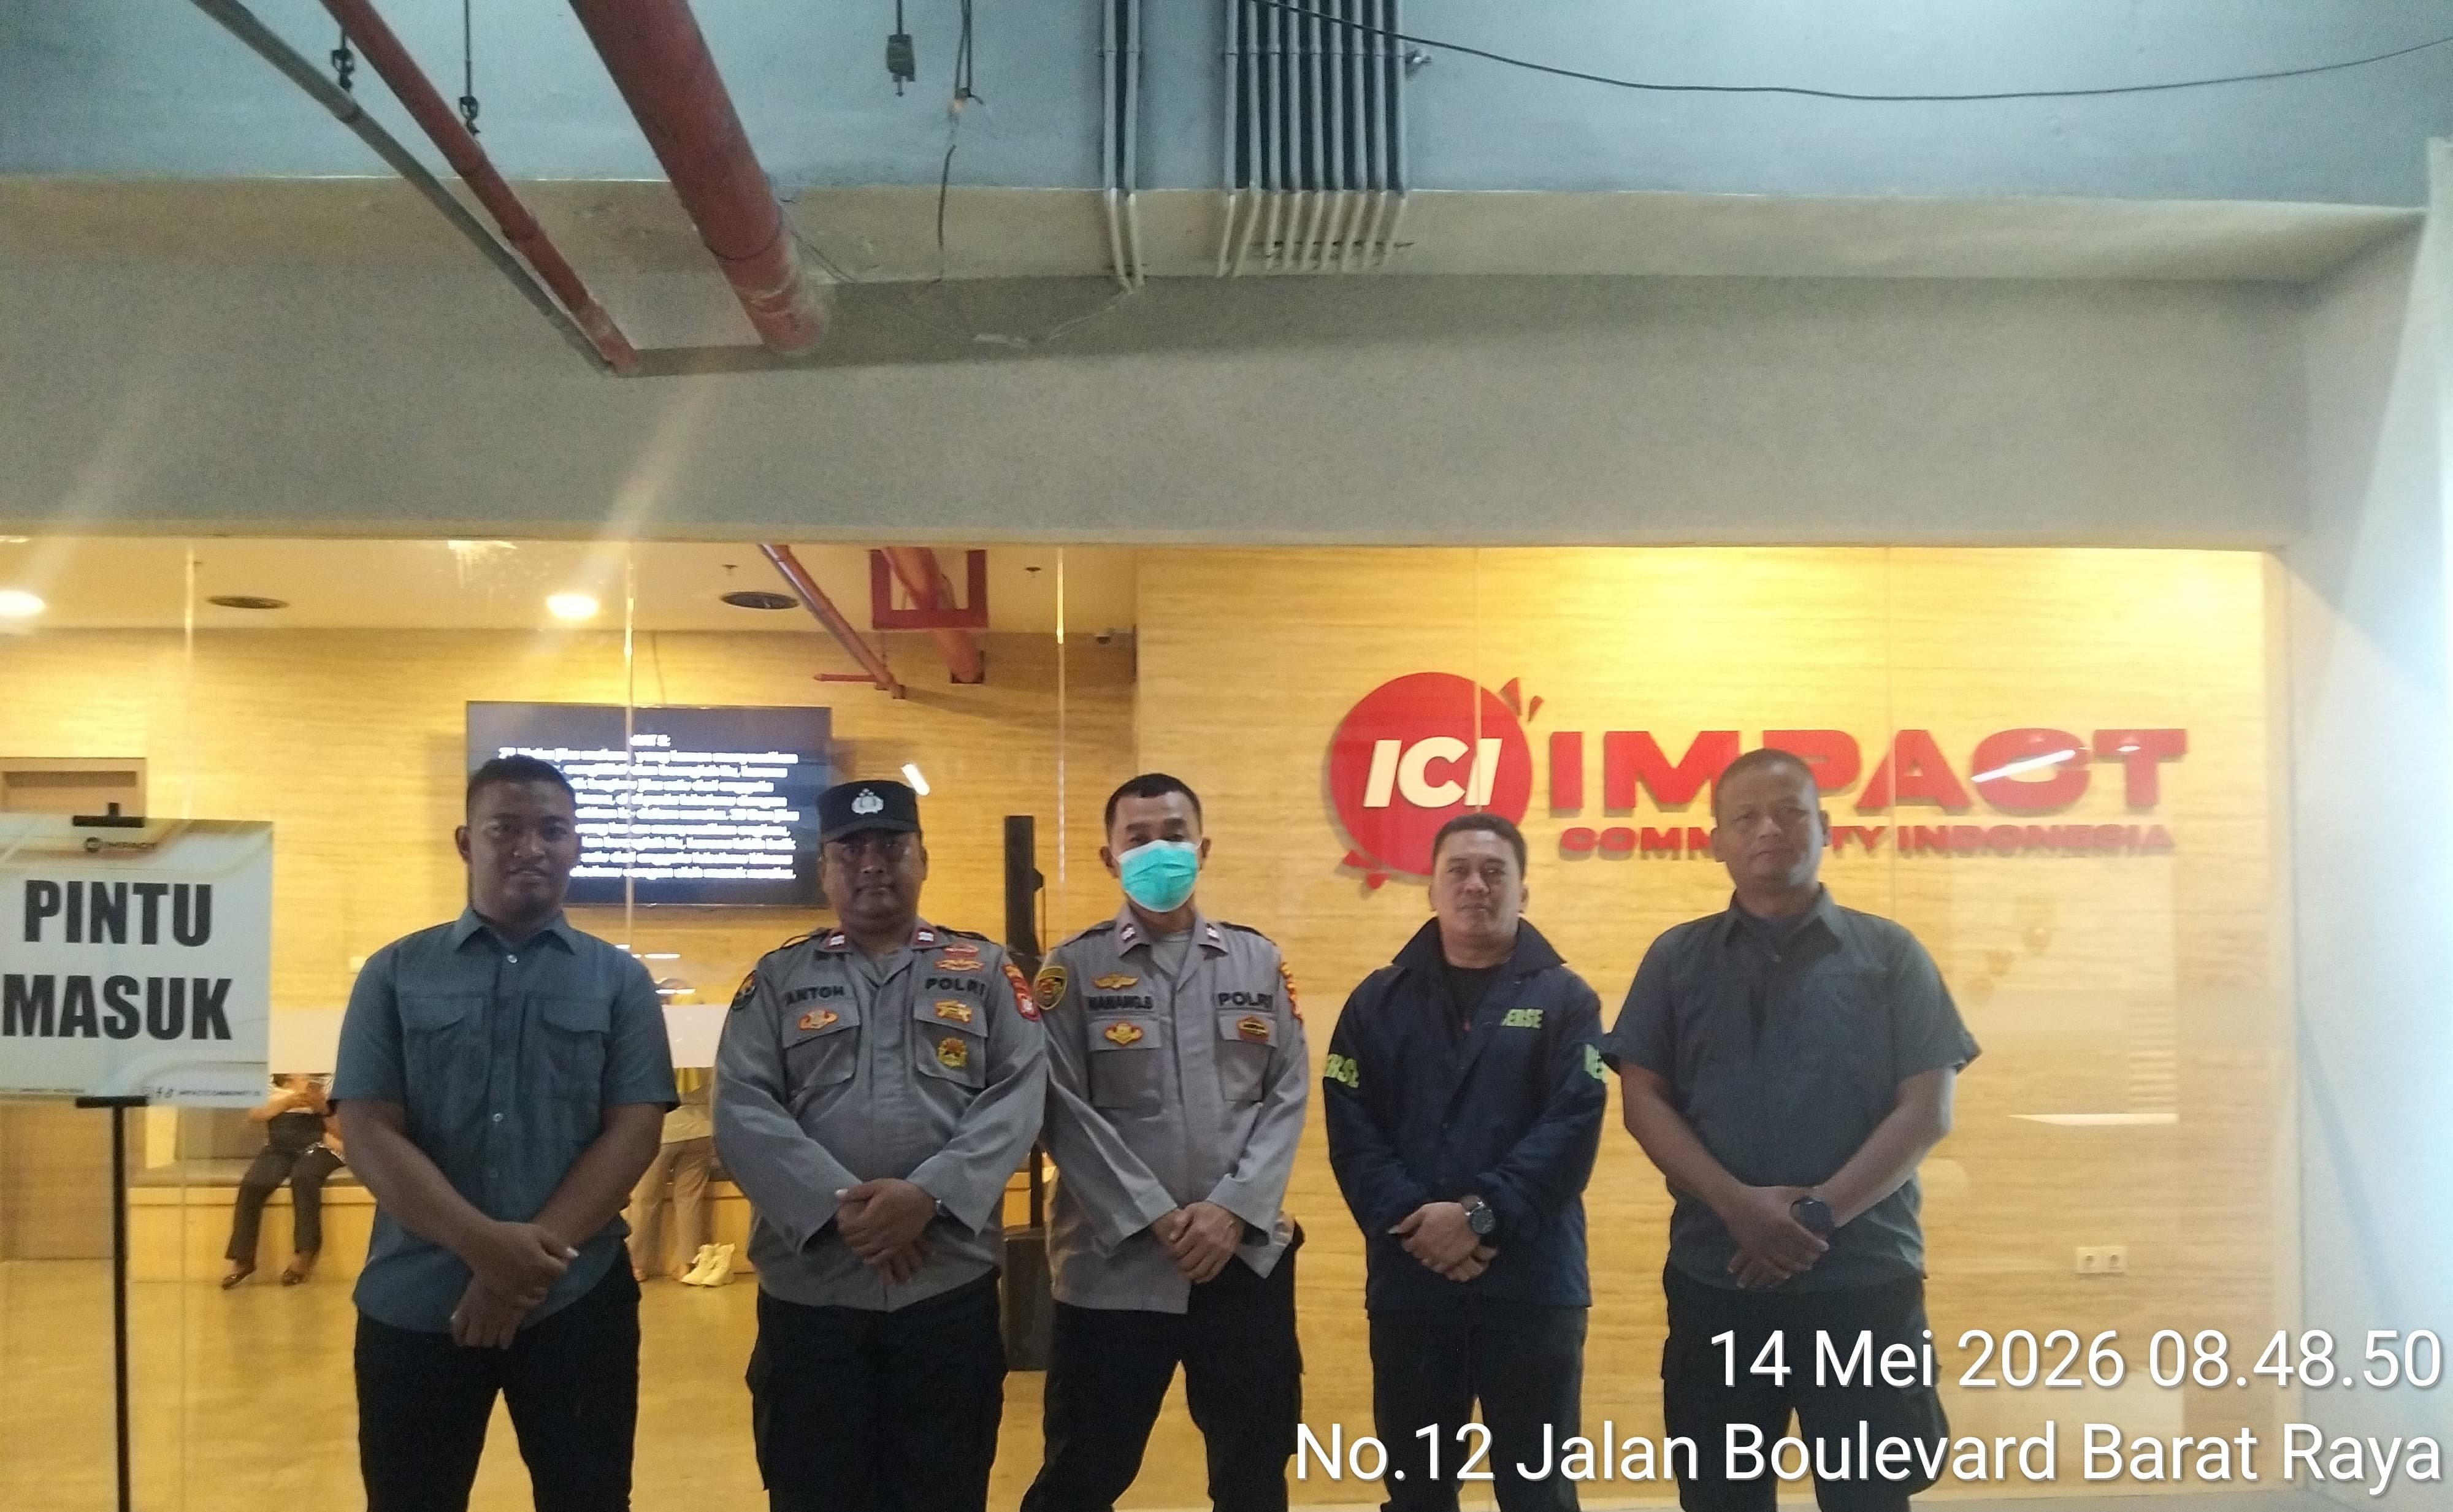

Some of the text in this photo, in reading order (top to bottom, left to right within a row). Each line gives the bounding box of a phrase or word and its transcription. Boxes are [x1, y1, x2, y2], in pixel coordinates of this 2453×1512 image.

[1363, 736, 1502, 808] ICI
[1552, 727, 2188, 809] IMPACT
[1896, 824, 2175, 850] INDONESIA
[25, 879, 213, 947] PINTU
[1, 973, 233, 1040] MASUK
[925, 977, 985, 996] POLRI
